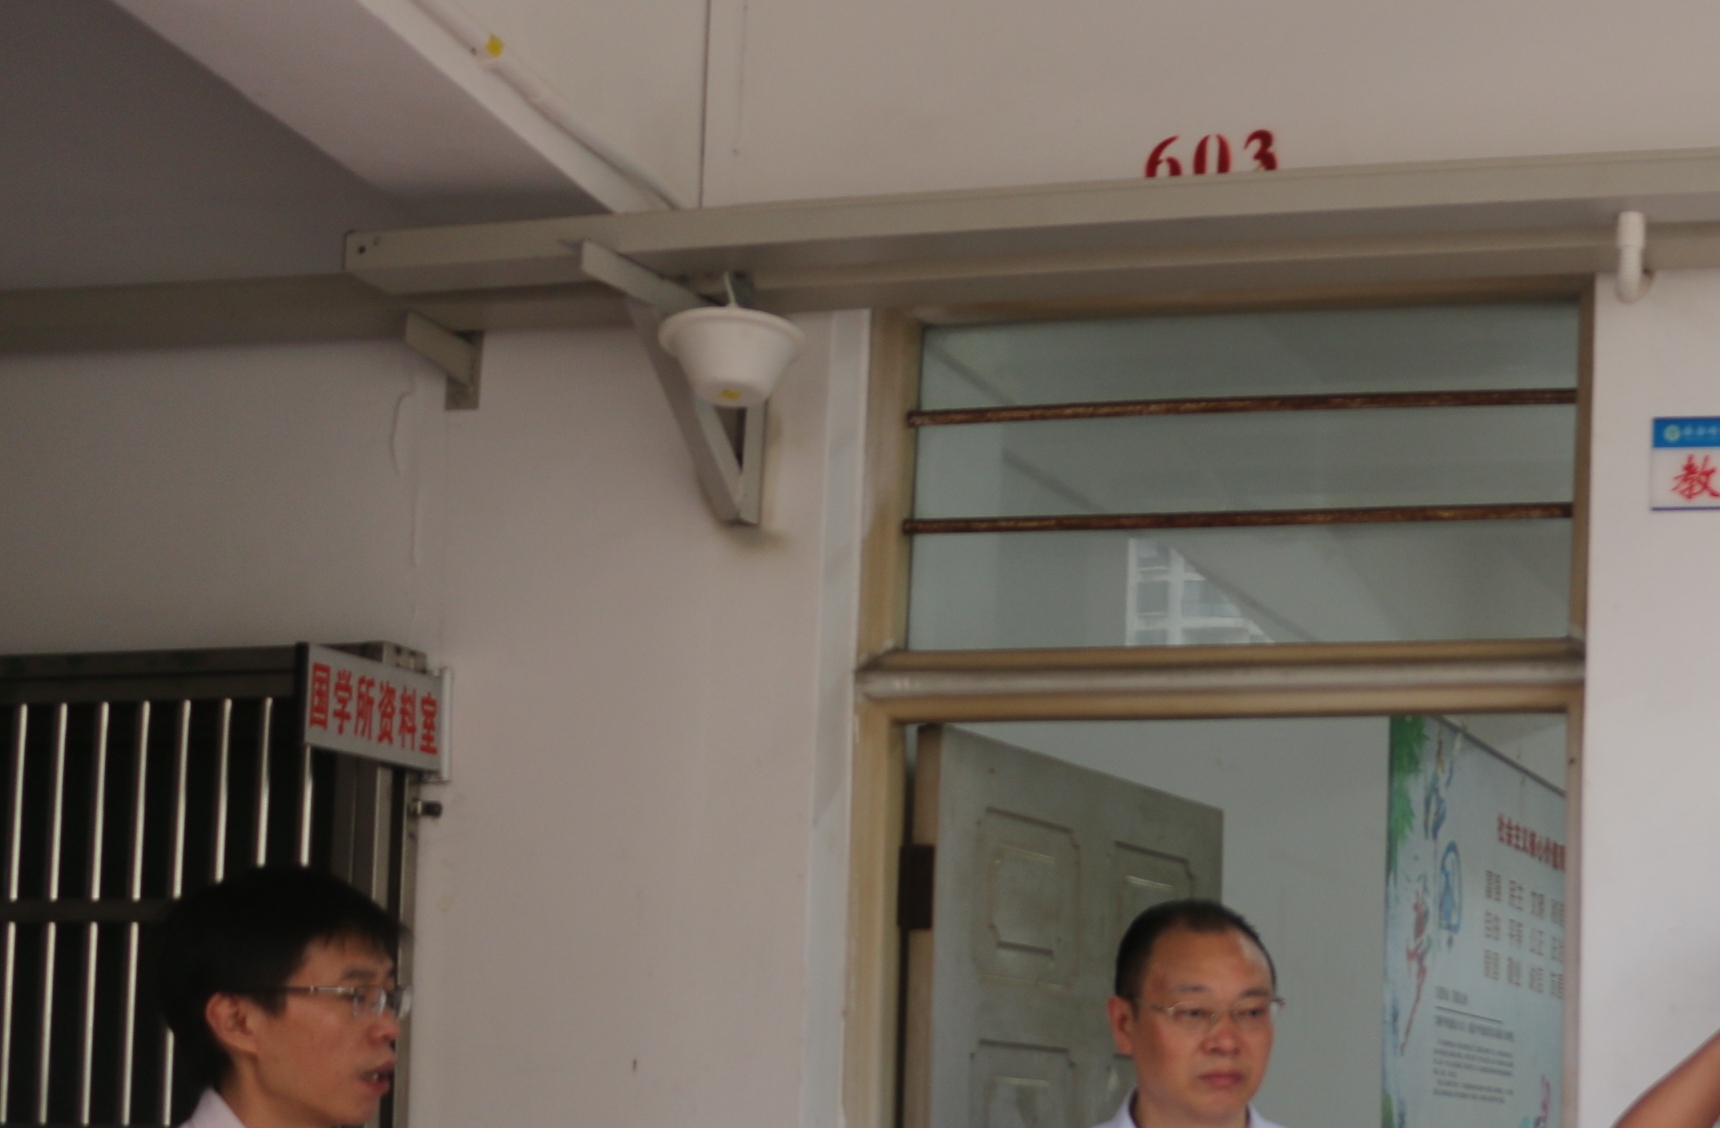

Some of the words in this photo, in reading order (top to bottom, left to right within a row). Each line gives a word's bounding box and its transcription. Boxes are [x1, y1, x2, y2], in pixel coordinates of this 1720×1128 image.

[1145, 128, 1277, 179] 603
[309, 661, 439, 757] 国学所资料室
